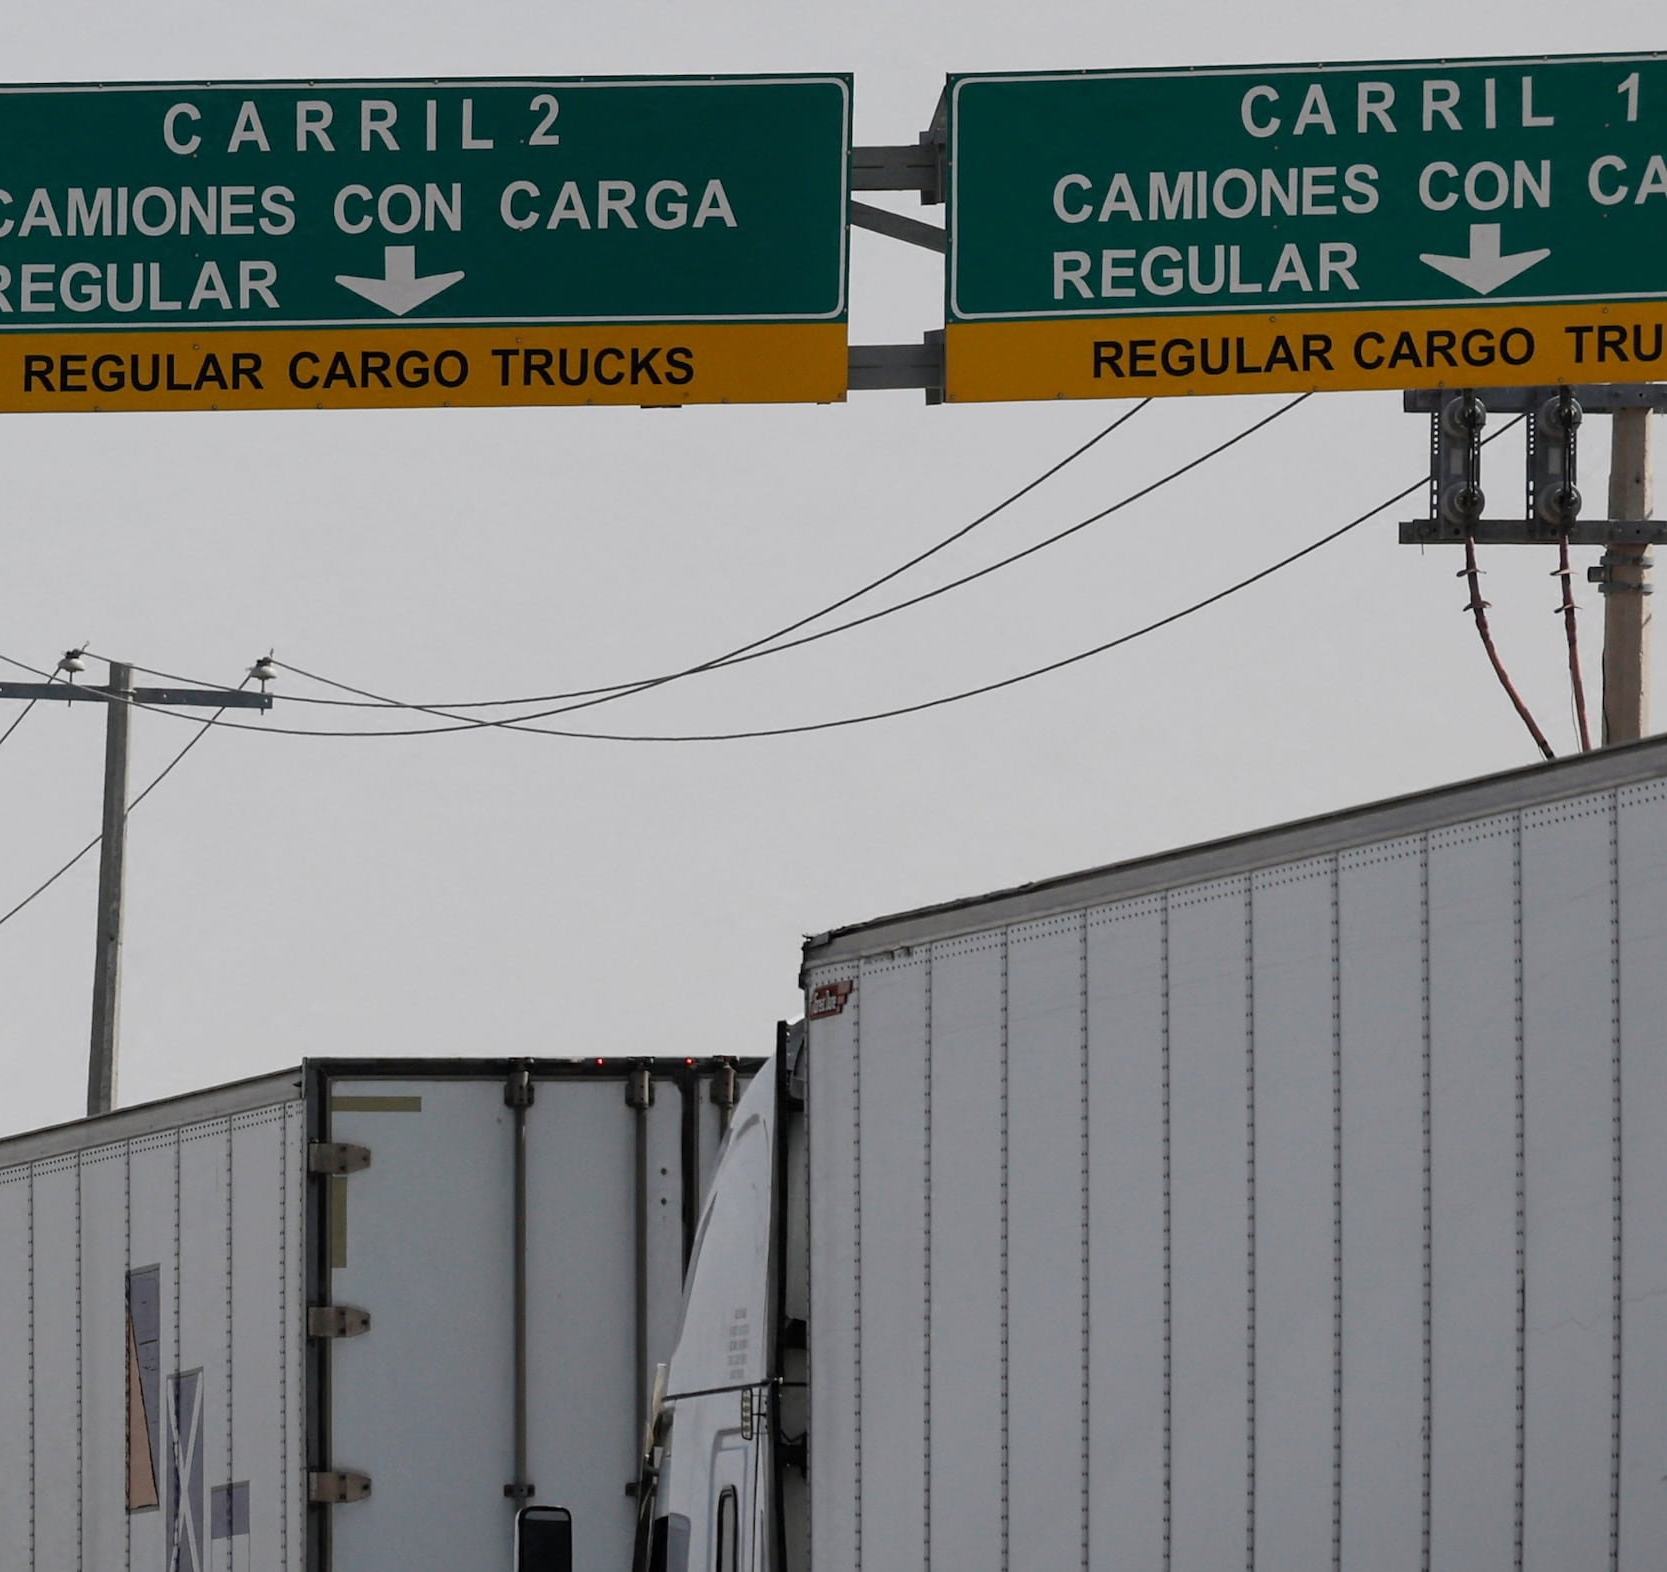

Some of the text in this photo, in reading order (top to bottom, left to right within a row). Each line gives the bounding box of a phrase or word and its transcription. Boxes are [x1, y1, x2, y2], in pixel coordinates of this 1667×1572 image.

[164, 95, 558, 154] CARRIL 2
[1242, 73, 1638, 137] CARRIL 1
[334, 183, 461, 233] CON
[501, 180, 737, 229] CARGA
[1054, 165, 1378, 223] CAMIONES
[1419, 160, 1550, 210] CON
[1054, 243, 1359, 299] REGULAR
[24, 347, 693, 392] REGULAR CARGO TRUCKS
[1094, 335, 1334, 378] REGULAR
[1354, 328, 1534, 369] CARGO
